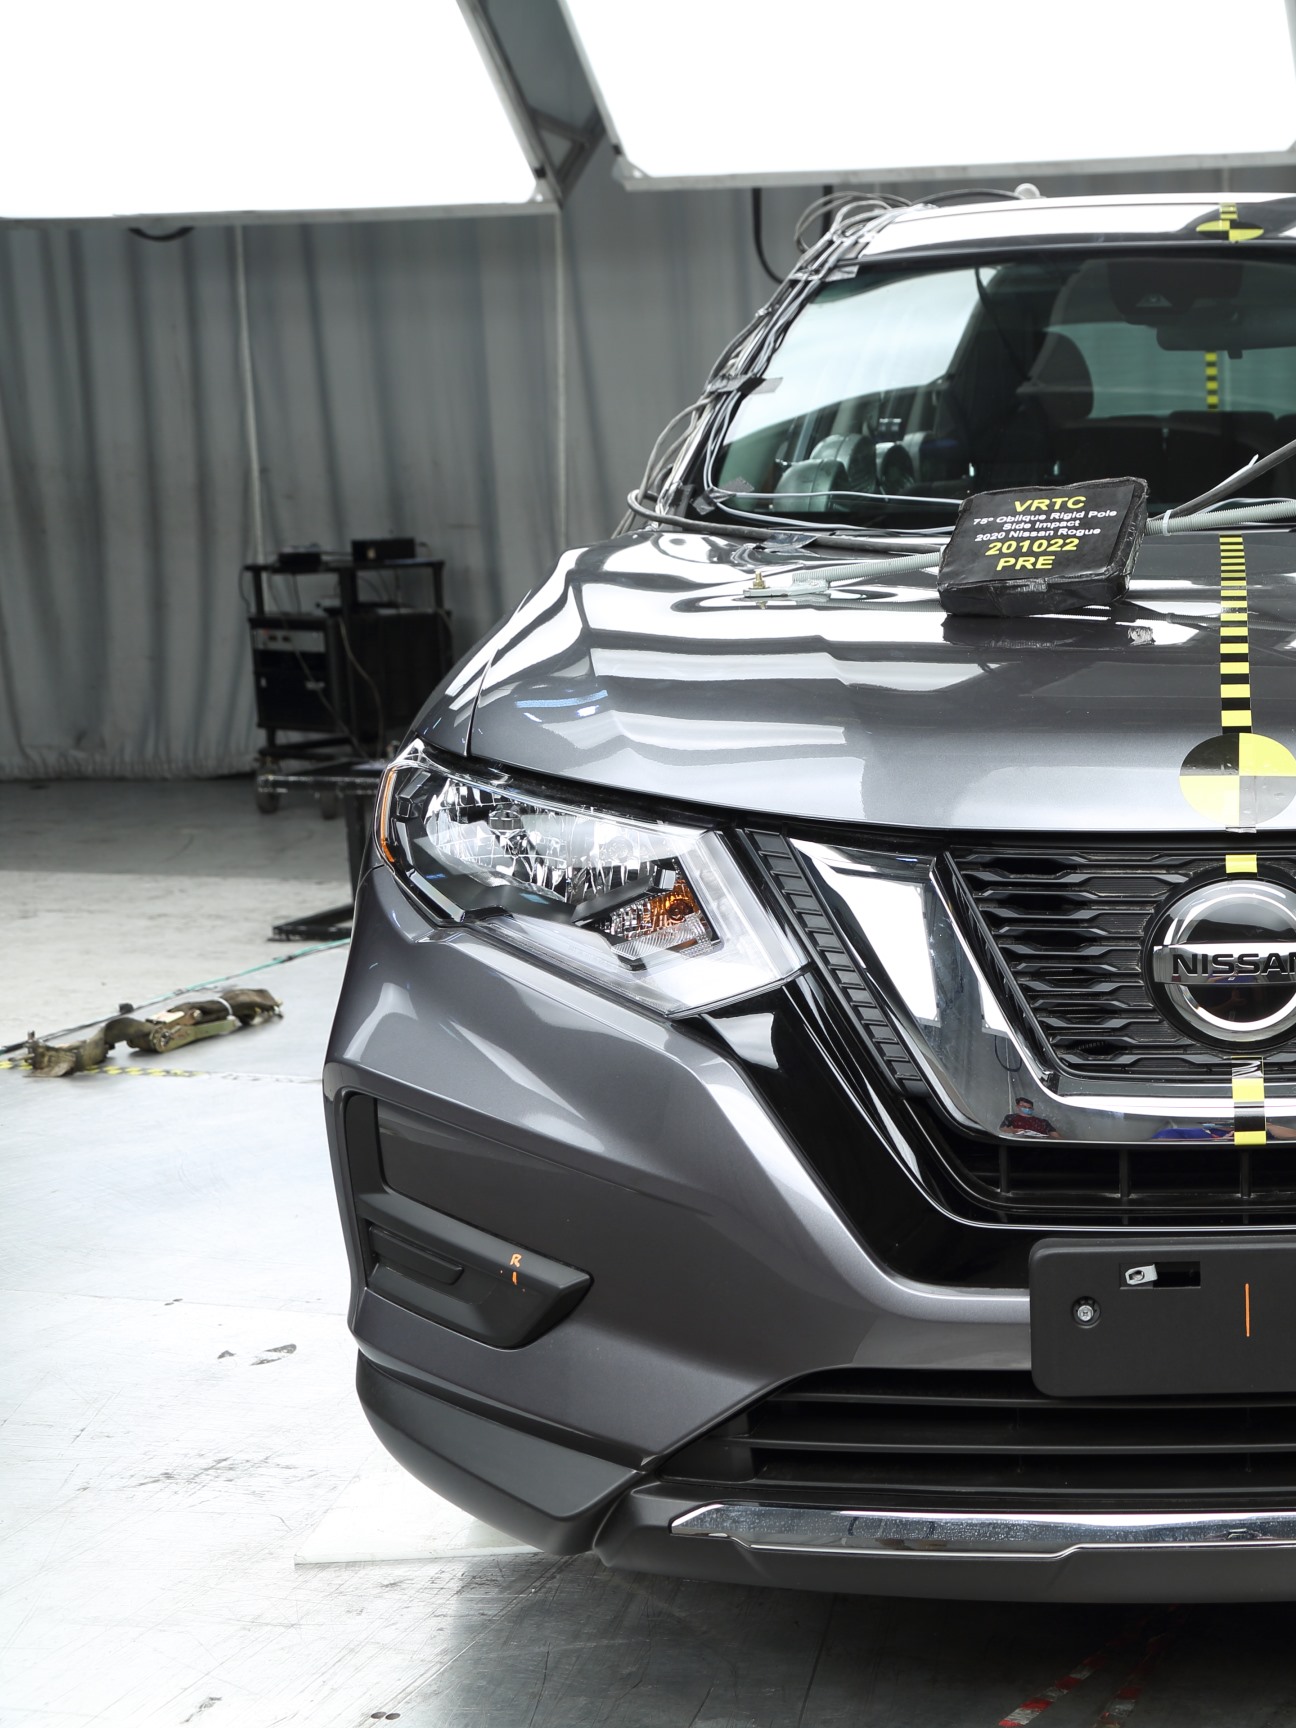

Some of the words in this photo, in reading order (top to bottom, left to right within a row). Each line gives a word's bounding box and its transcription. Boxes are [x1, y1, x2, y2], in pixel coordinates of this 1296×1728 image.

[1014, 496, 1086, 512] VRTC
[997, 514, 1046, 524] Oblique
[1050, 511, 1084, 520] Rigid
[1088, 510, 1116, 519] Pole
[1003, 522, 1031, 530] Side
[1034, 520, 1080, 529] Impact
[974, 532, 1005, 541] 2020
[1009, 529, 1054, 538] Nissan
[1058, 528, 1101, 537] Rogue
[985, 538, 1080, 555] 201022
[996, 556, 1056, 570] PRE
